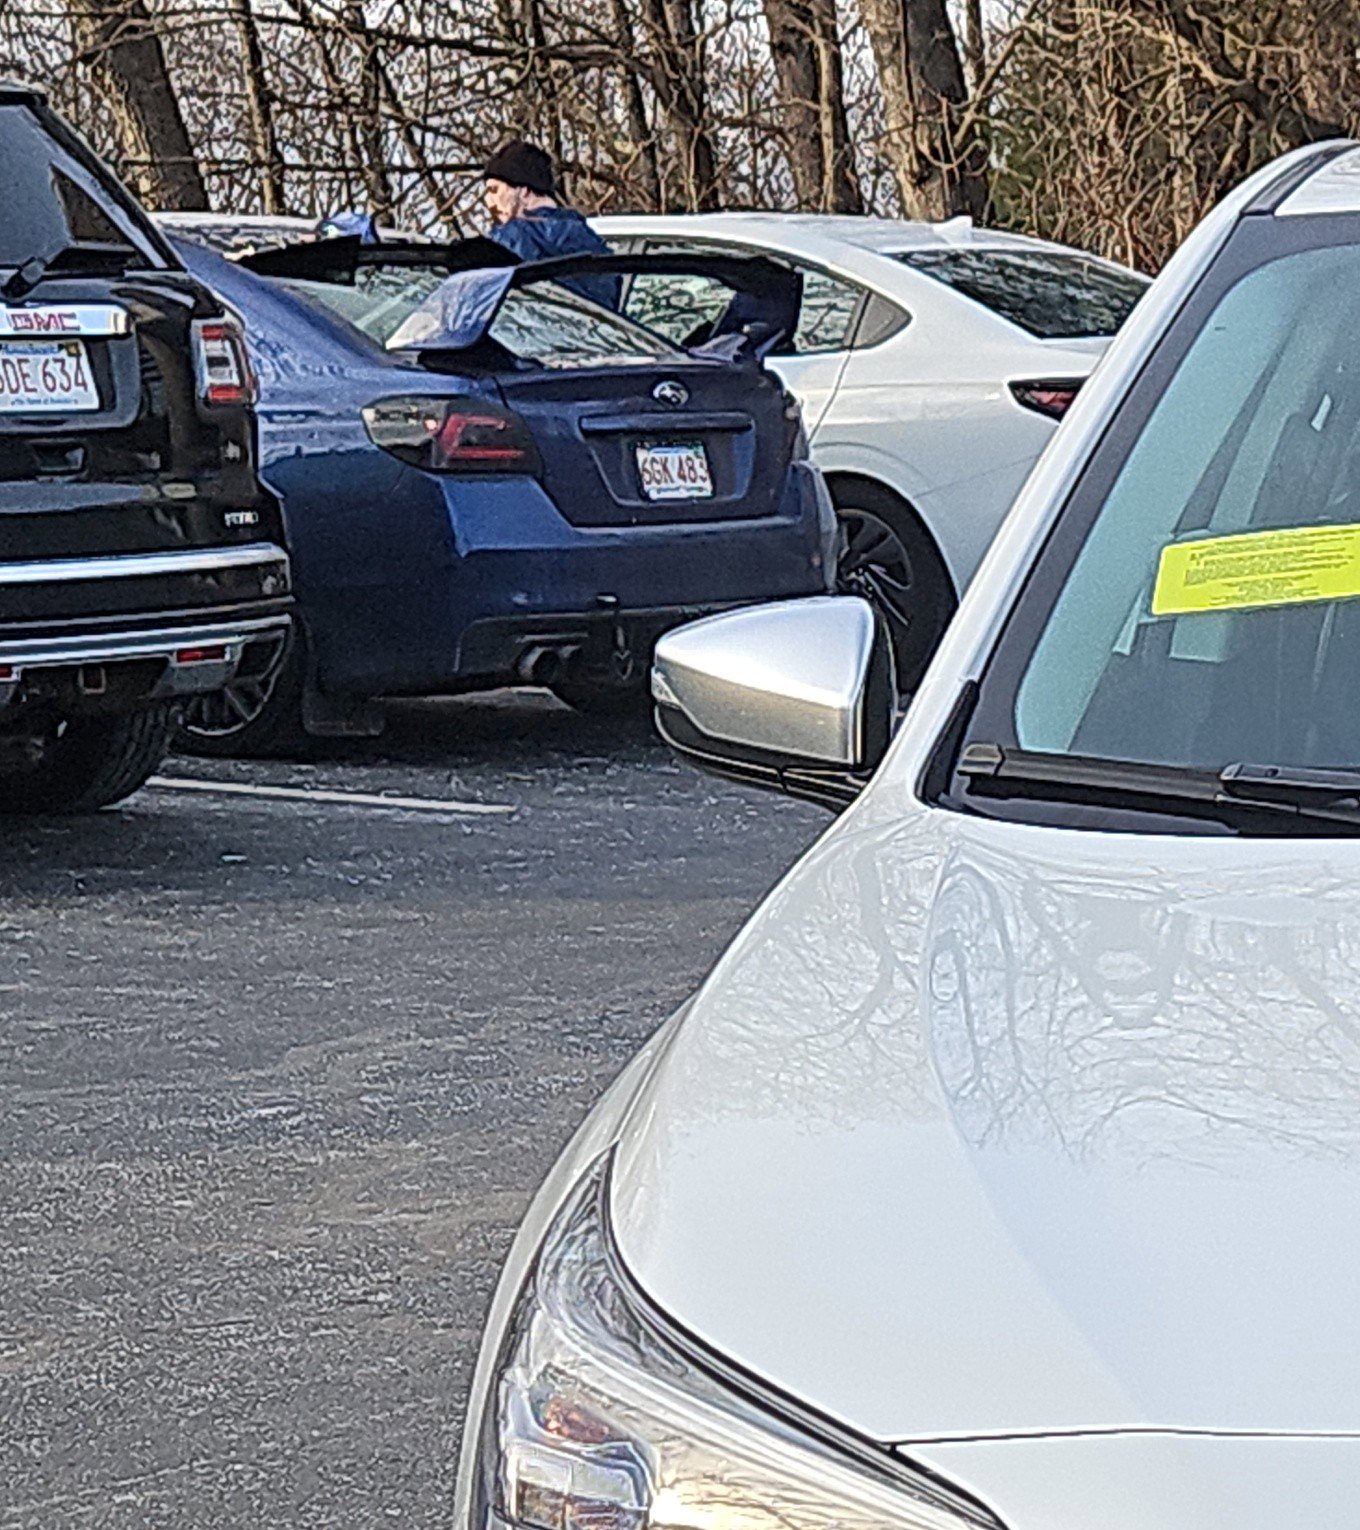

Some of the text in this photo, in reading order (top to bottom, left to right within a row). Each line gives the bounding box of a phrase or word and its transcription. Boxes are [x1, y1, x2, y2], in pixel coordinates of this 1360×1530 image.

[10, 312, 80, 331] GMC
[41, 355, 89, 393] 634
[641, 456, 675, 485] 6GK
